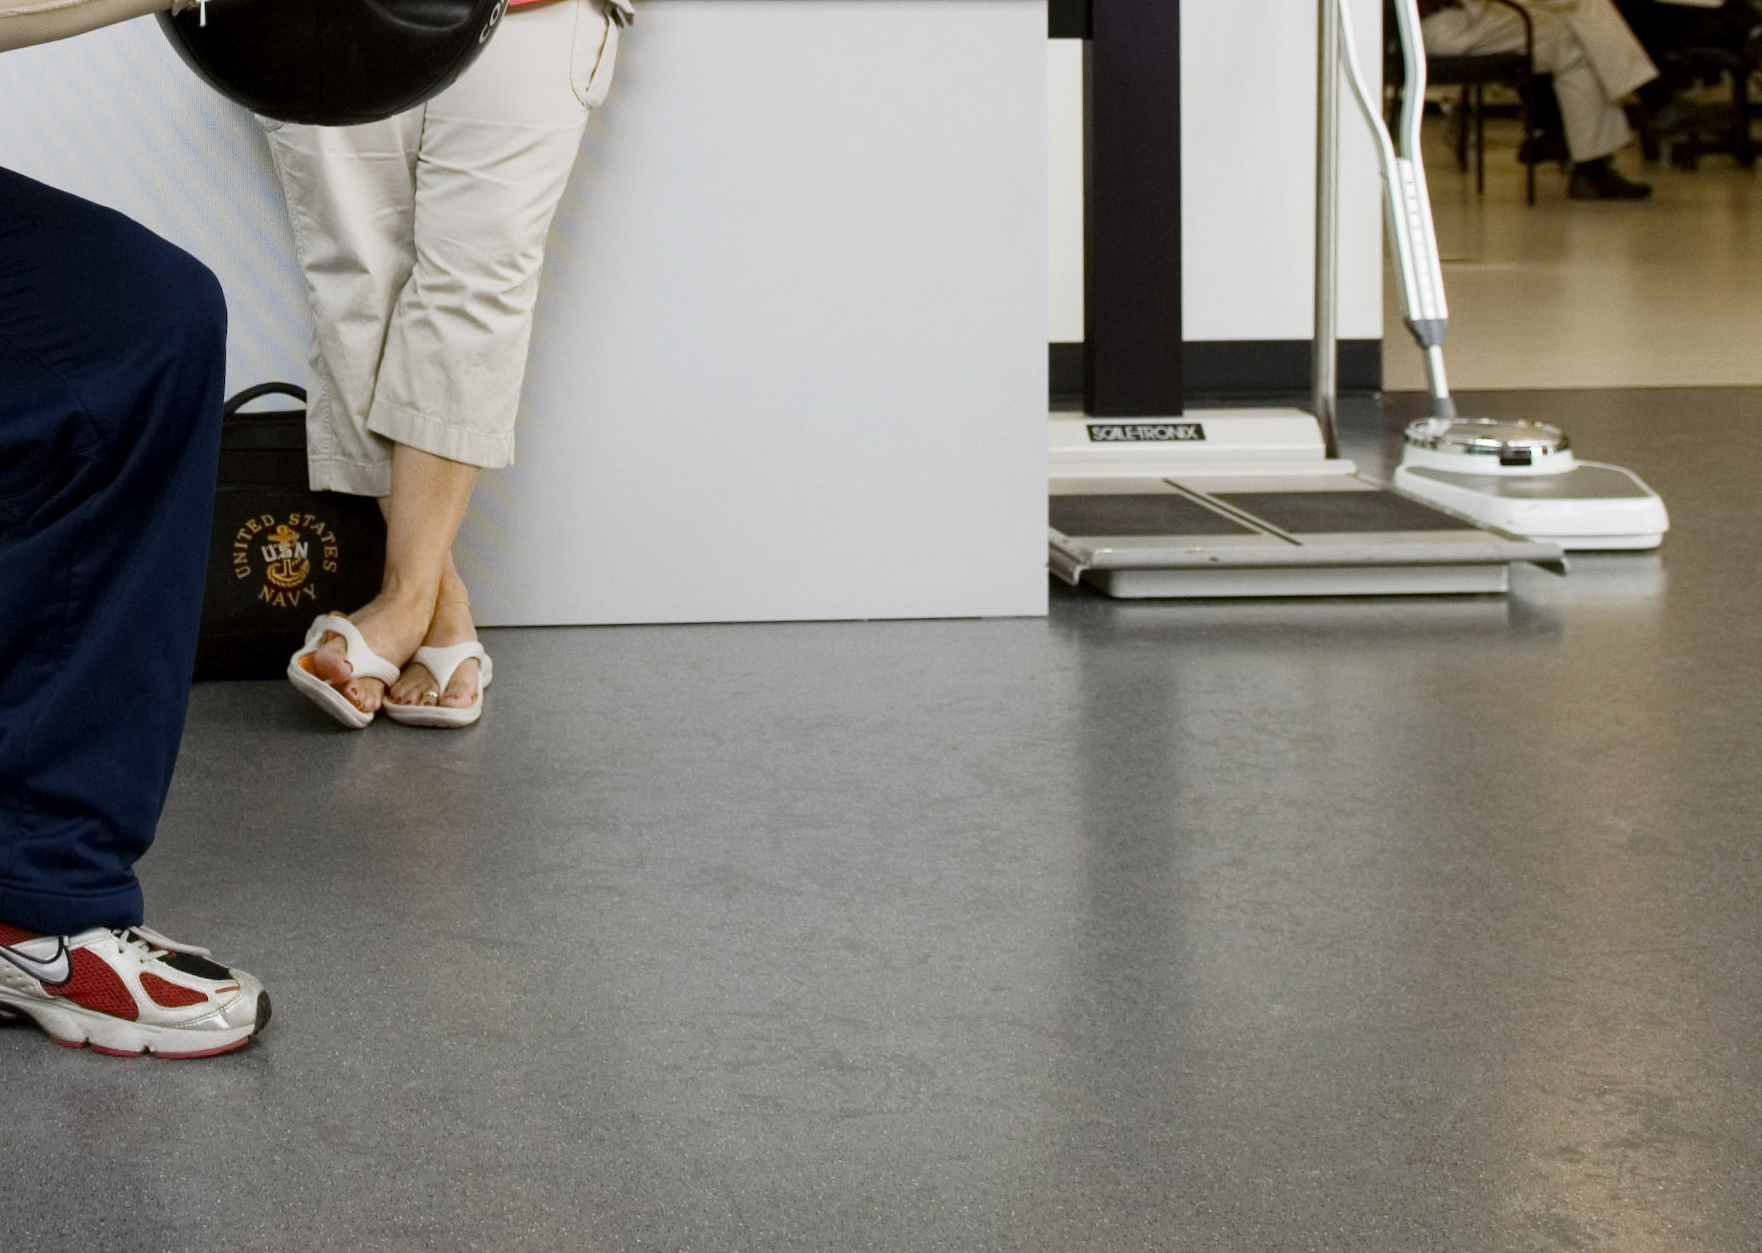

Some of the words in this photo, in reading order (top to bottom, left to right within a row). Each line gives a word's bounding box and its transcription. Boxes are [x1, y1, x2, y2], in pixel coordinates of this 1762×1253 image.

[1091, 426, 1199, 441] SCALE-TRONIX
[233, 514, 275, 580] UNITED
[288, 513, 338, 573] STATES
[261, 541, 309, 563] USN
[257, 583, 317, 607] NAVY
